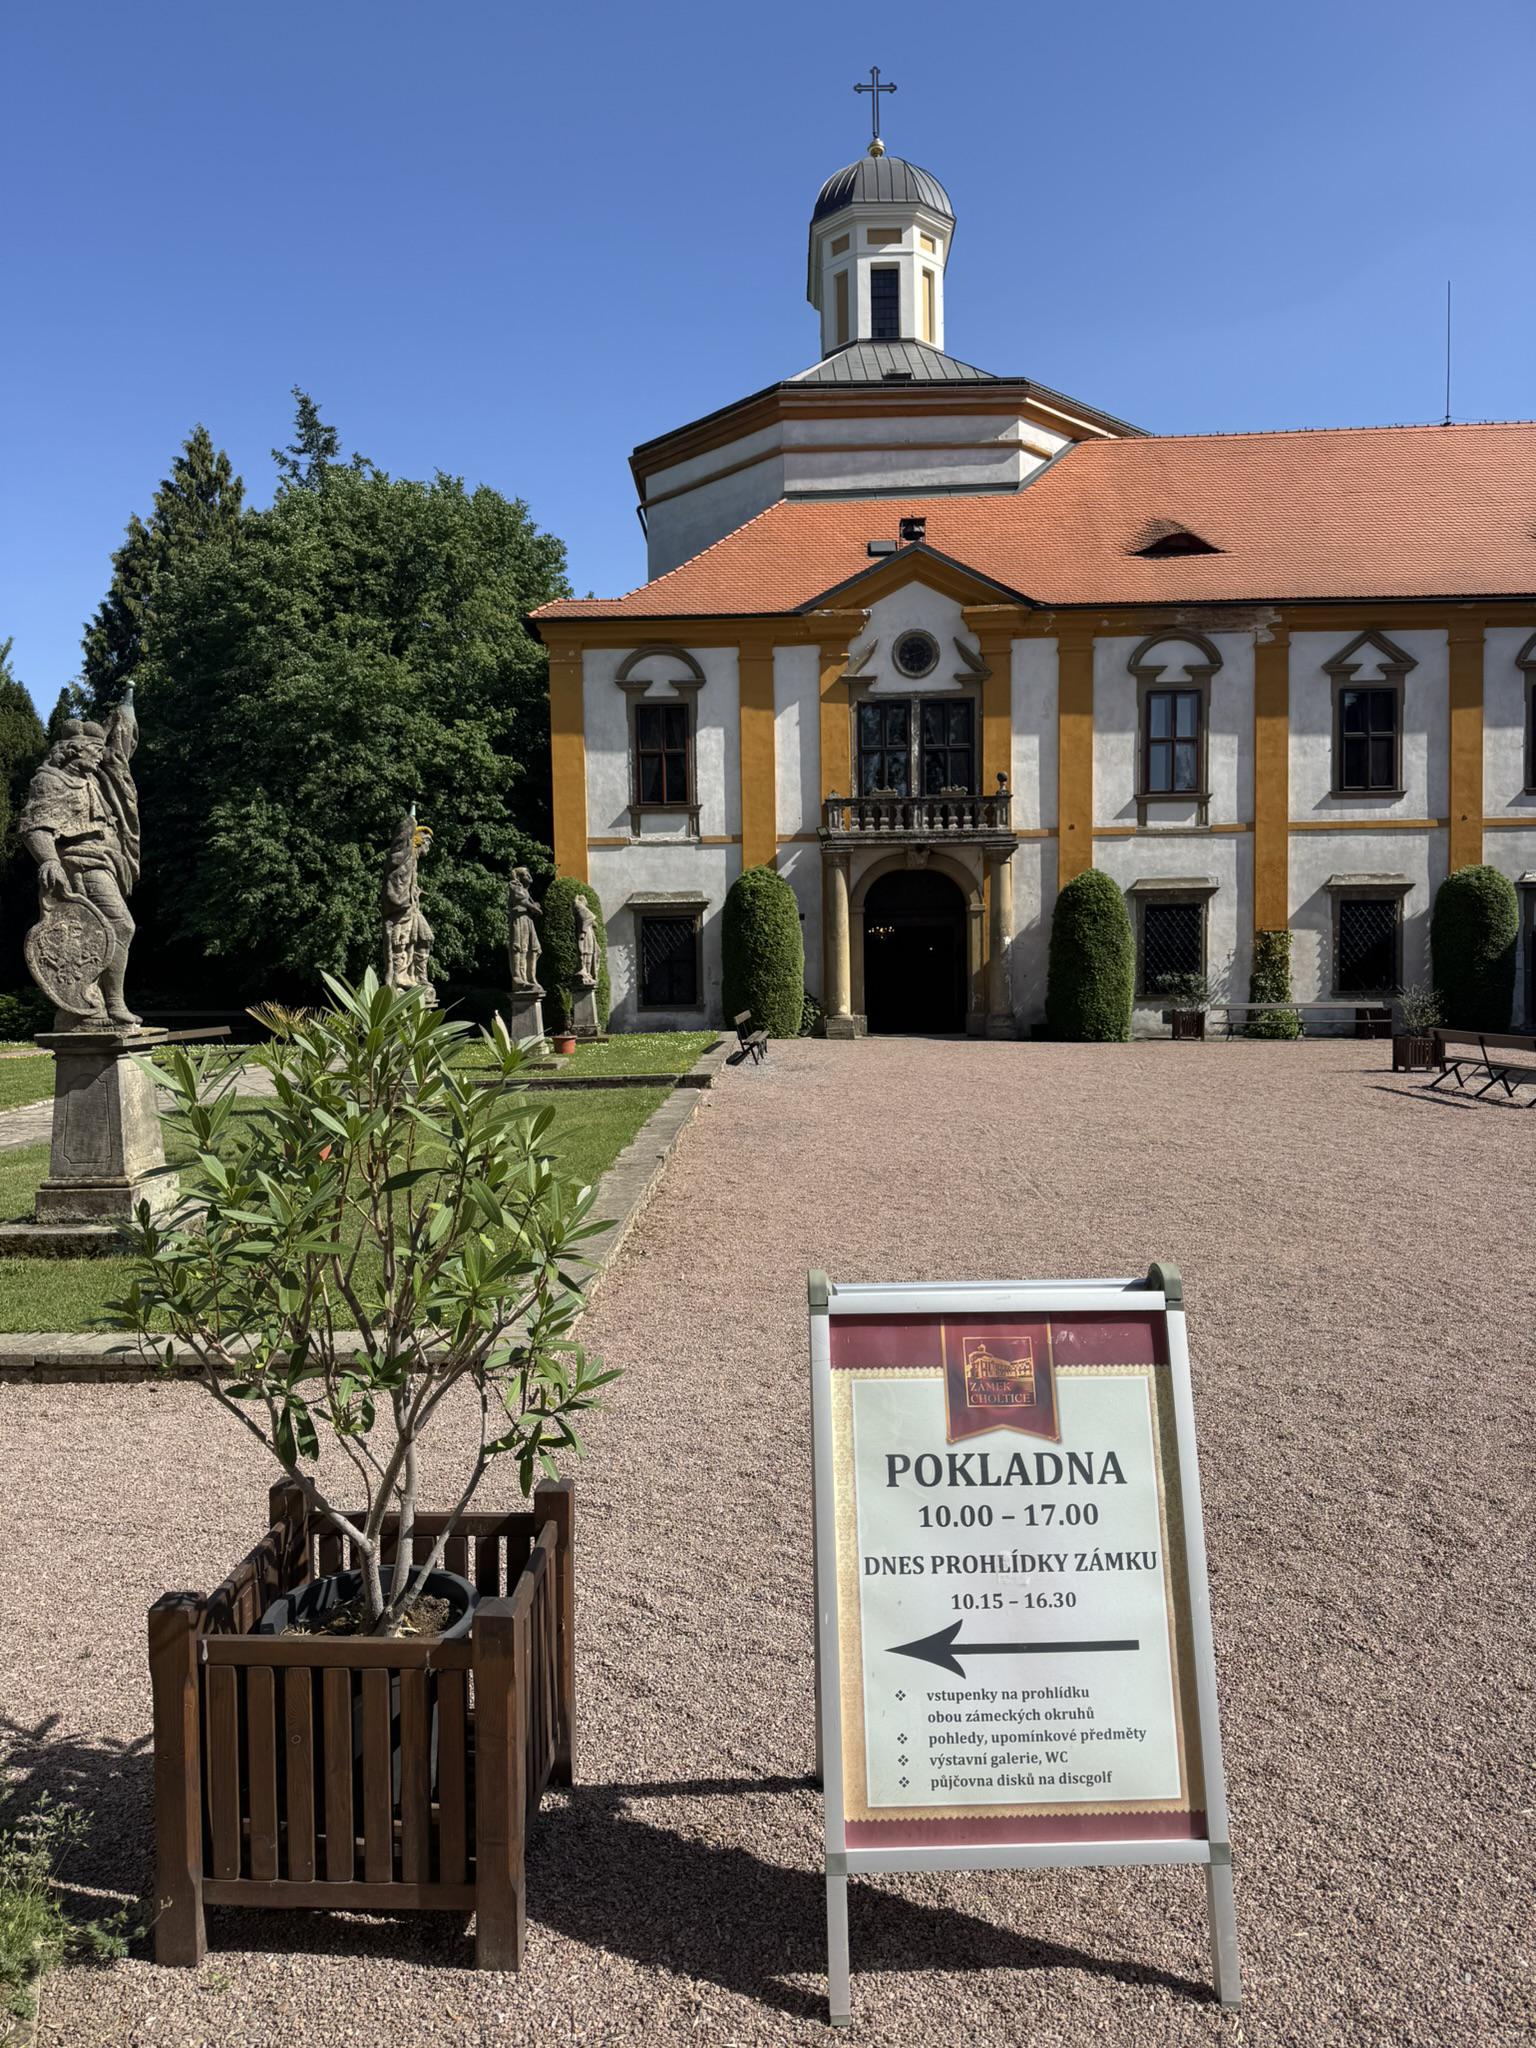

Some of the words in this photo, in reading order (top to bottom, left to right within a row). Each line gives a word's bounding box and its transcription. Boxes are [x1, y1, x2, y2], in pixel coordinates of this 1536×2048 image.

[970, 1393, 1031, 1404] CHOLTICE
[884, 1450, 1128, 1488] POKLADNA
[918, 1504, 994, 1528] 10.00
[1023, 1502, 1099, 1527] 17.00
[863, 1555, 925, 1576] DNES
[930, 1548, 1069, 1575] PROHLÍDKY
[1074, 1546, 1157, 1572] ZÁMKU
[951, 1592, 1004, 1610] 10.15
[1024, 1591, 1077, 1609] 16.30
[926, 1687, 998, 1705] vstupenky
[1000, 1690, 1019, 1701] na
[1021, 1685, 1090, 1703] prohlídku
[927, 1710, 962, 1724] obou
[964, 1708, 1042, 1725] zámeckých
[1044, 1706, 1095, 1721] okruhů
[928, 1731, 988, 1749] pohledy,
[990, 1728, 1077, 1747] upomínkové
[1080, 1727, 1147, 1745] předměty
[929, 1751, 988, 1769] výstavní
[990, 1751, 1043, 1769] galerie,
[1044, 1750, 1069, 1764] WC
[930, 1774, 994, 1792] půjčovna
[996, 1772, 1035, 1787] disků
[1038, 1775, 1056, 1786] na
[1058, 1770, 1113, 1788] discgolf
